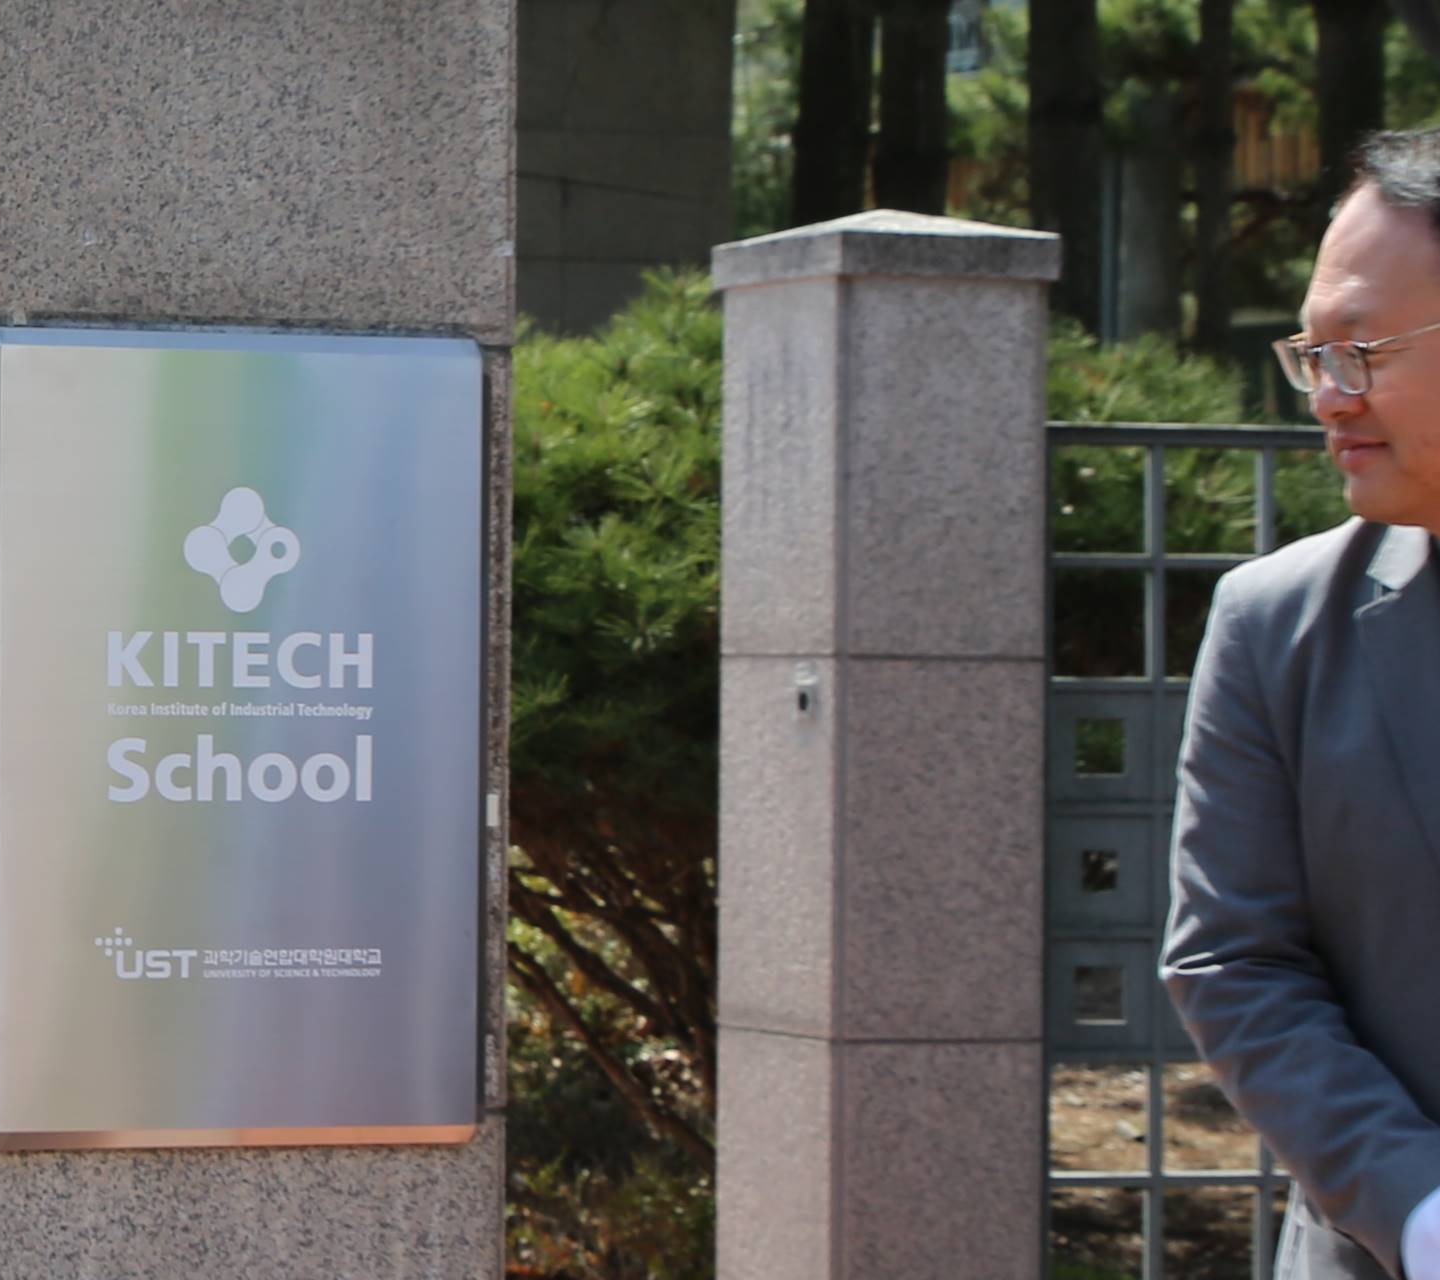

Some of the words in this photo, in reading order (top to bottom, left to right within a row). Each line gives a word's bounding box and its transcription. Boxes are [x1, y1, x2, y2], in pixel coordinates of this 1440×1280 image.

[107, 631, 374, 689] KITECH
[107, 703, 147, 716] Korea
[151, 702, 209, 717] Institute
[212, 702, 227, 717] of
[230, 703, 294, 717] Industrial
[297, 703, 373, 719] Technology
[106, 734, 373, 802] School
[116, 949, 198, 979] UST
[203, 948, 382, 967] 과학기술연합대학원대학교
